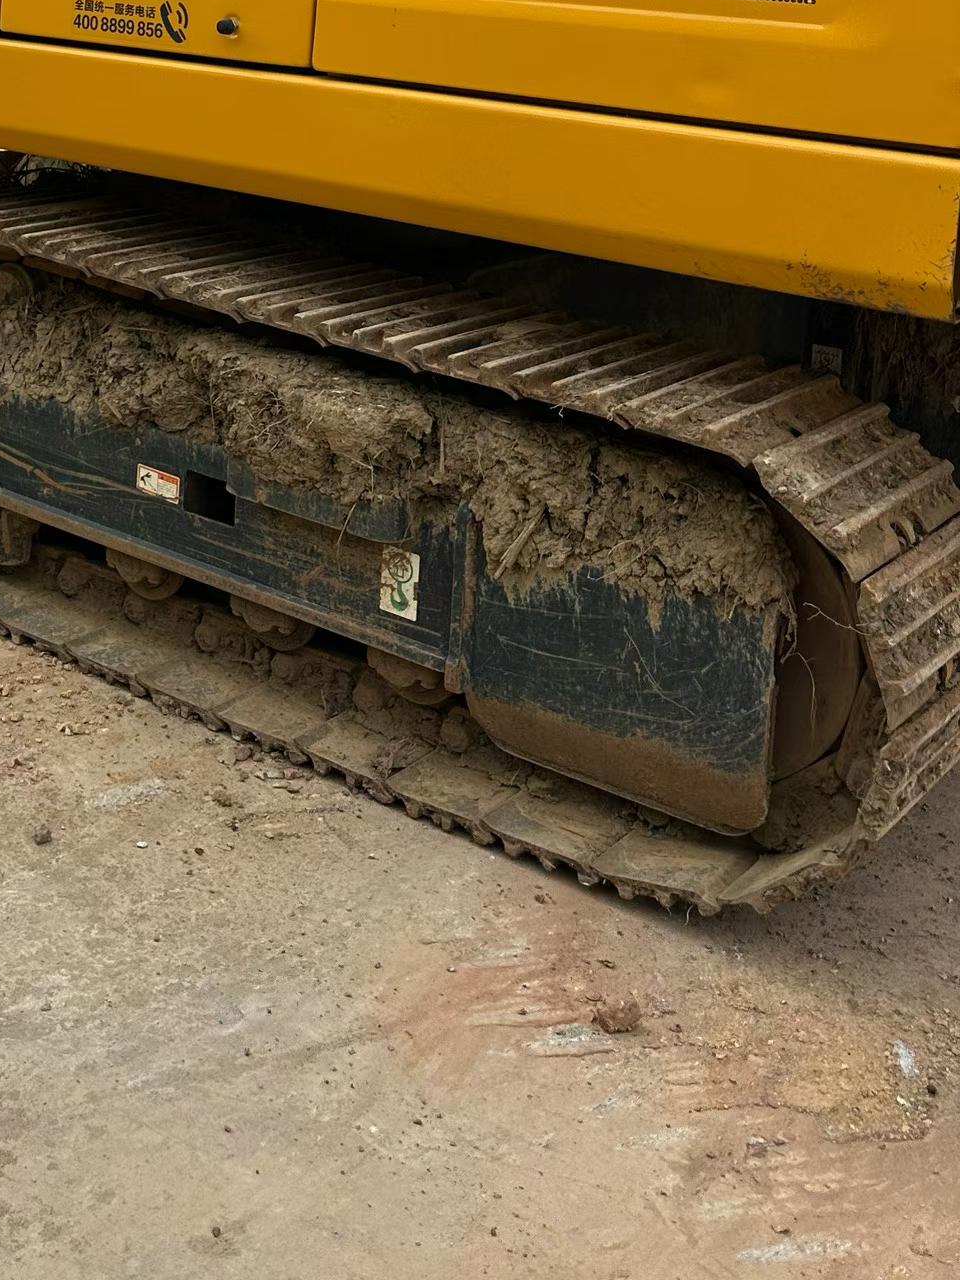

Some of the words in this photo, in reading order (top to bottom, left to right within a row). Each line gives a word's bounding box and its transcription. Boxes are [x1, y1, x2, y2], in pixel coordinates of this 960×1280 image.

[73, 13, 99, 31] 400
[100, 16, 135, 35] 8899
[137, 21, 163, 39] 856
